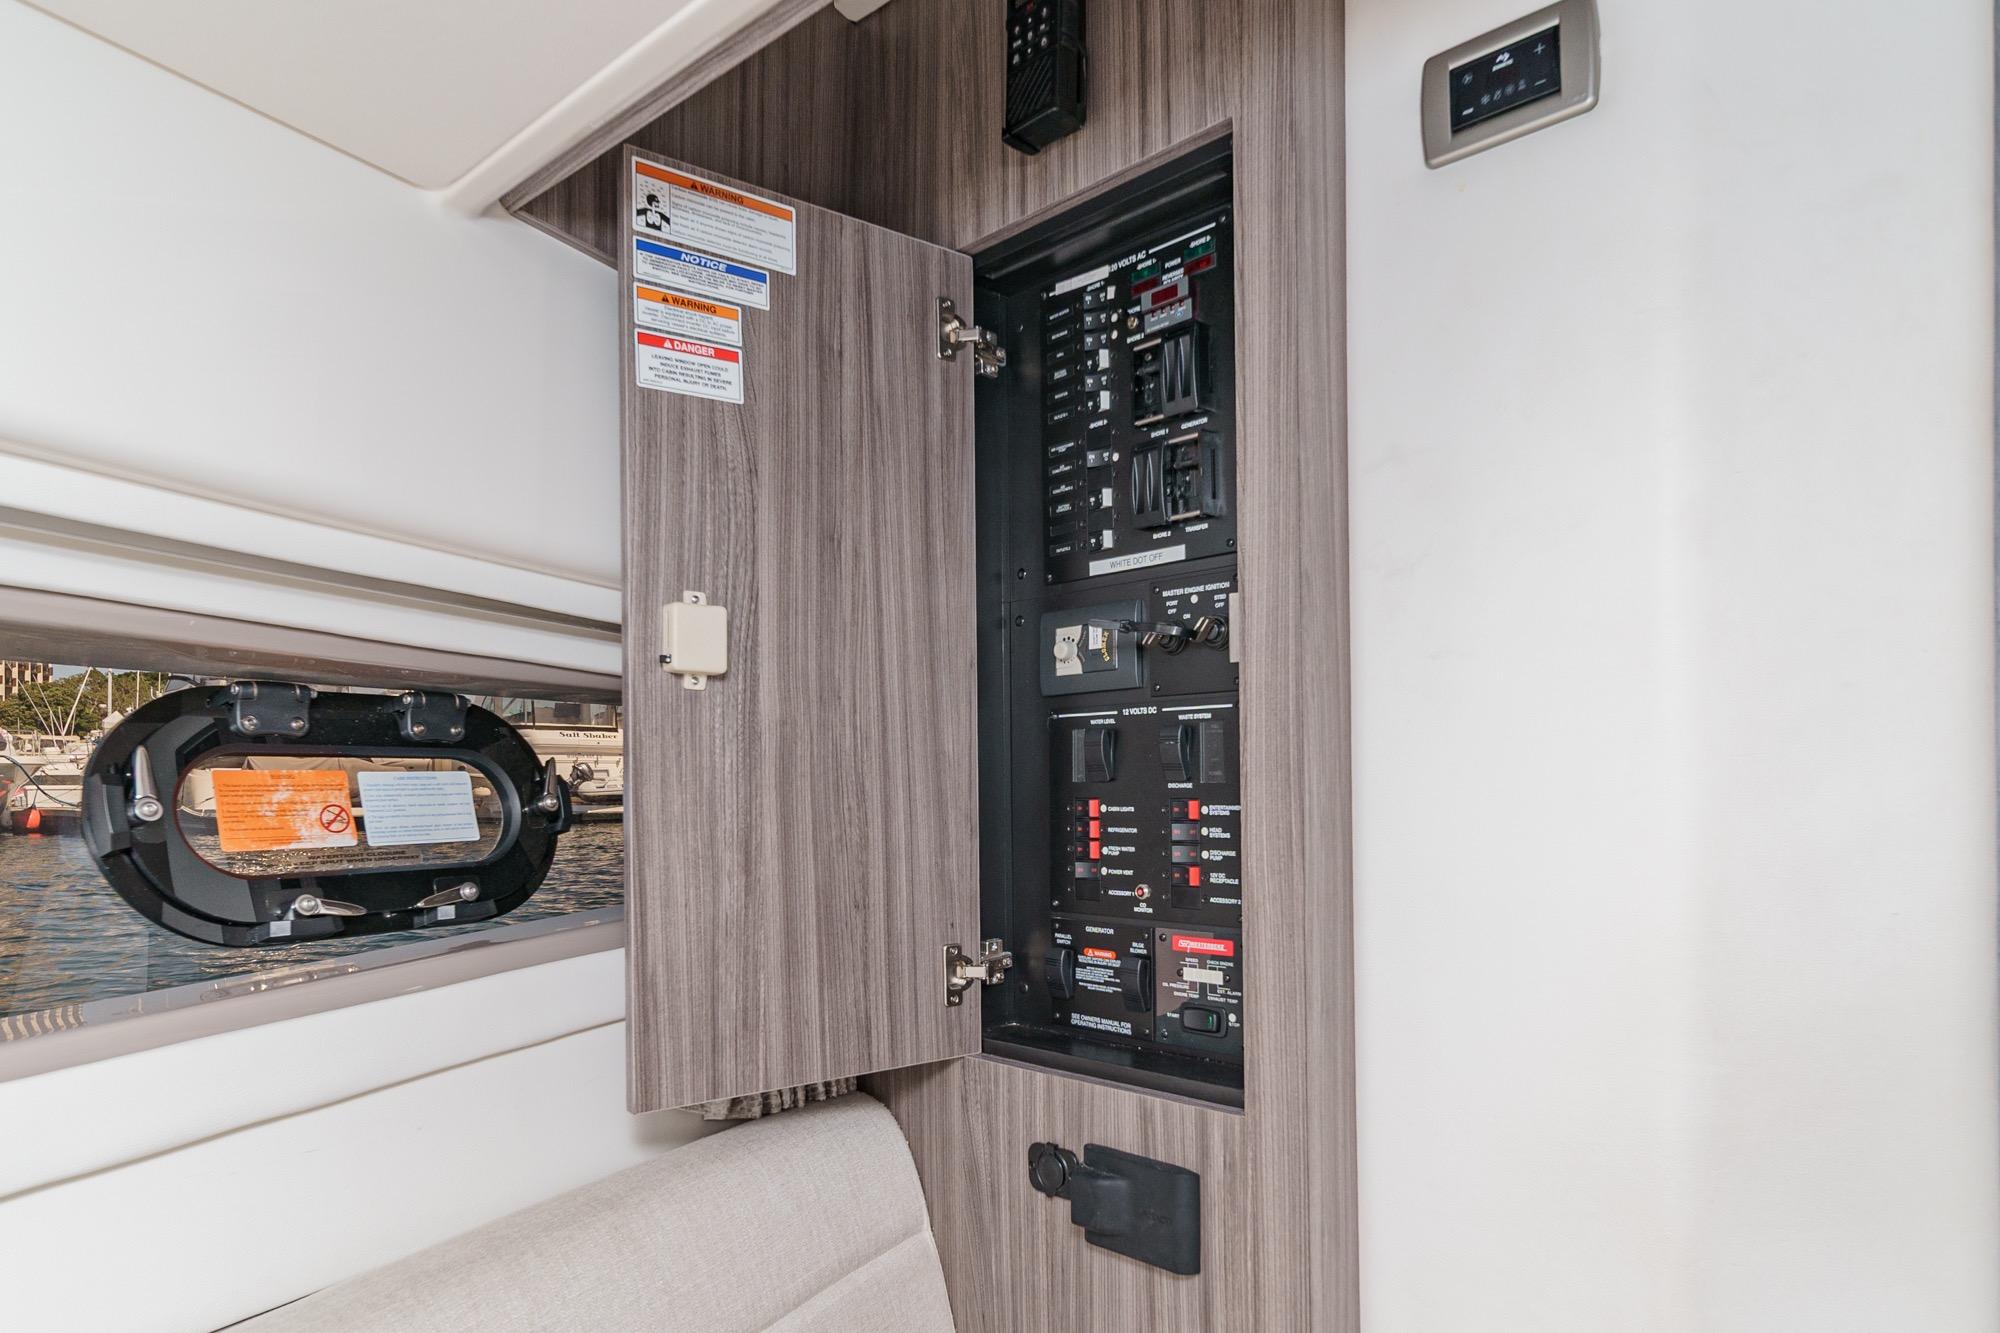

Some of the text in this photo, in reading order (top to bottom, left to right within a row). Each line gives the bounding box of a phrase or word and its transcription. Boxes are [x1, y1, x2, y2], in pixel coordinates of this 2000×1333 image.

[700, 184, 744, 205] WARNING
[681, 252, 728, 272] NOTICE
[1118, 254, 1136, 268] VOLTS
[1137, 250, 1146, 260] AC
[671, 296, 716, 314] WARNING
[674, 340, 715, 357] DANGER
[1181, 416, 1208, 430] GENERATOR
[1151, 428, 1165, 438] SHORE
[1185, 523, 1208, 532] TRANSFER
[1110, 552, 1163, 568] WHITE DOT OFF
[1162, 581, 1230, 597] MASTER ENGINE IGNITION
[1123, 708, 1129, 716] 12
[1130, 707, 1147, 715] VOLTS
[1086, 926, 1114, 935] GENERATOR
[1071, 1019, 1132, 1035] OPERATING INSTRUCTIONS
[1081, 1014, 1100, 1022] OWNERS
[1101, 1018, 1120, 1027] MANUAL
